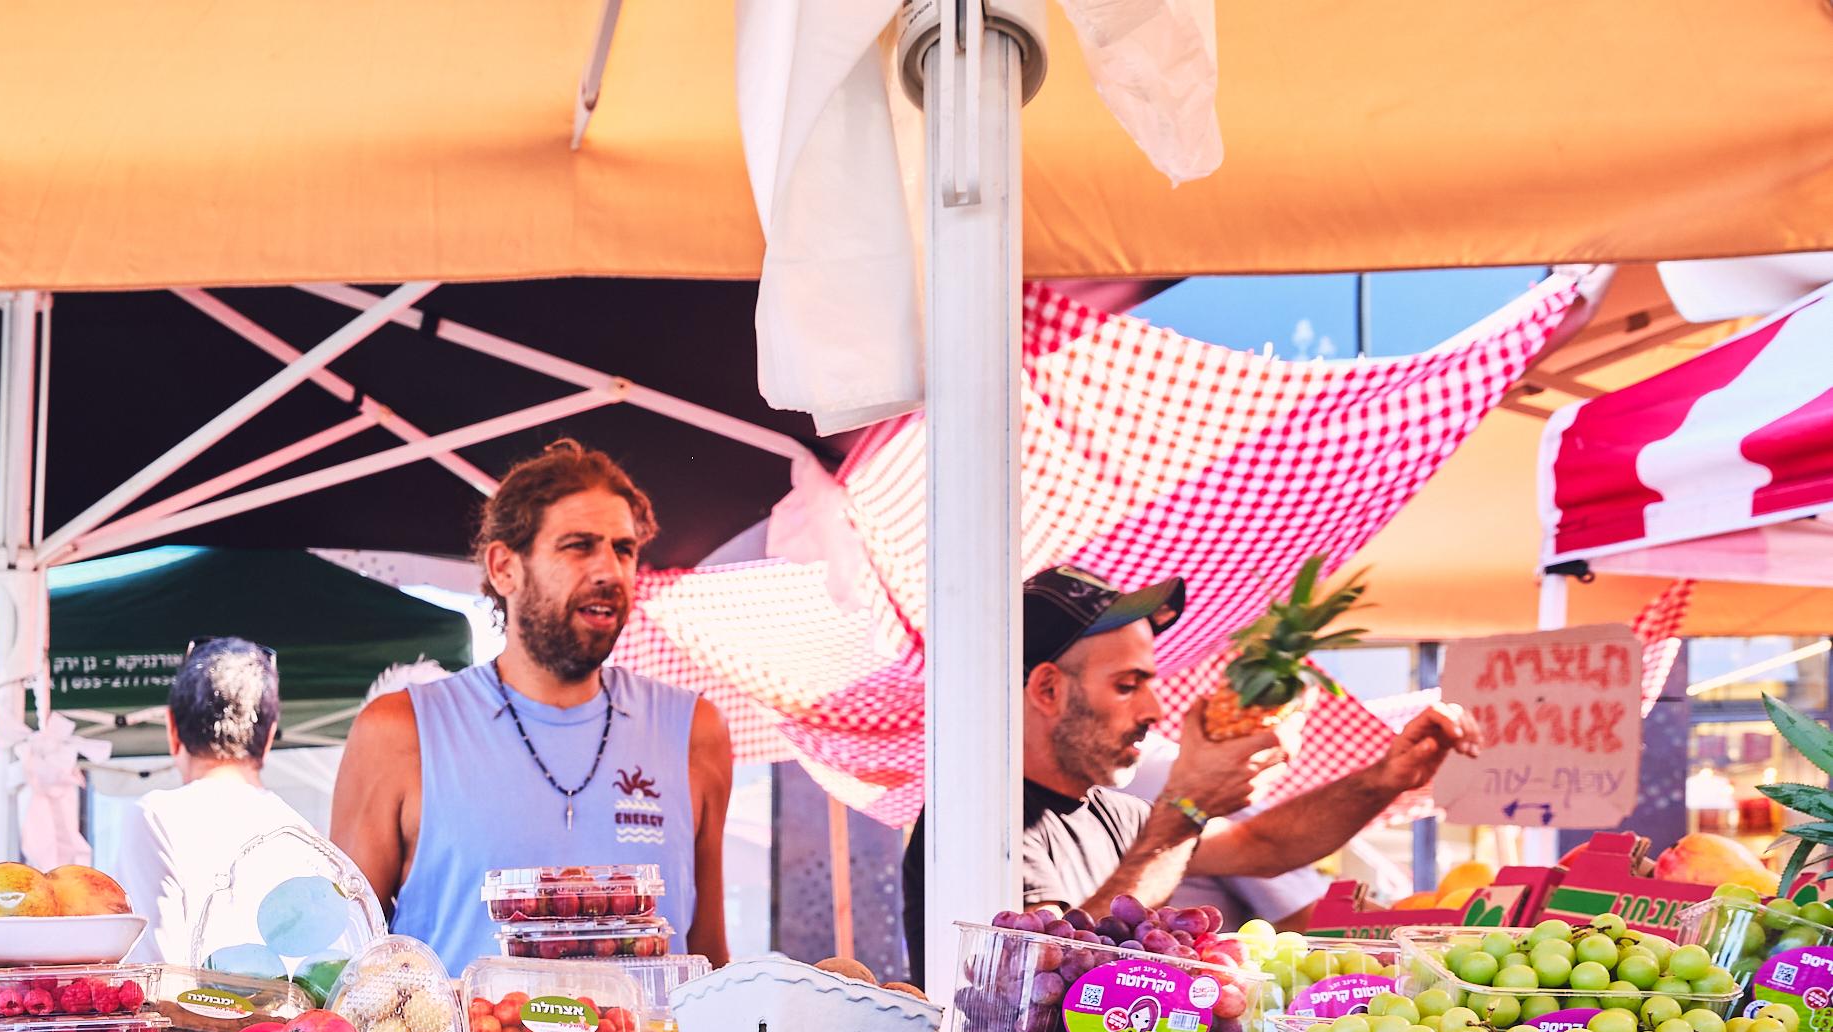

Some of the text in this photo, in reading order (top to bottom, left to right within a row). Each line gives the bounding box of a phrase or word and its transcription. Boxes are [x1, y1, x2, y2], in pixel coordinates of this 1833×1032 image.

[615, 812, 664, 828] ENERGY
[1116, 972, 1176, 994] סקרלוטה
[1309, 989, 1351, 1004] קריספ
[530, 1001, 585, 1016] אצרולה
